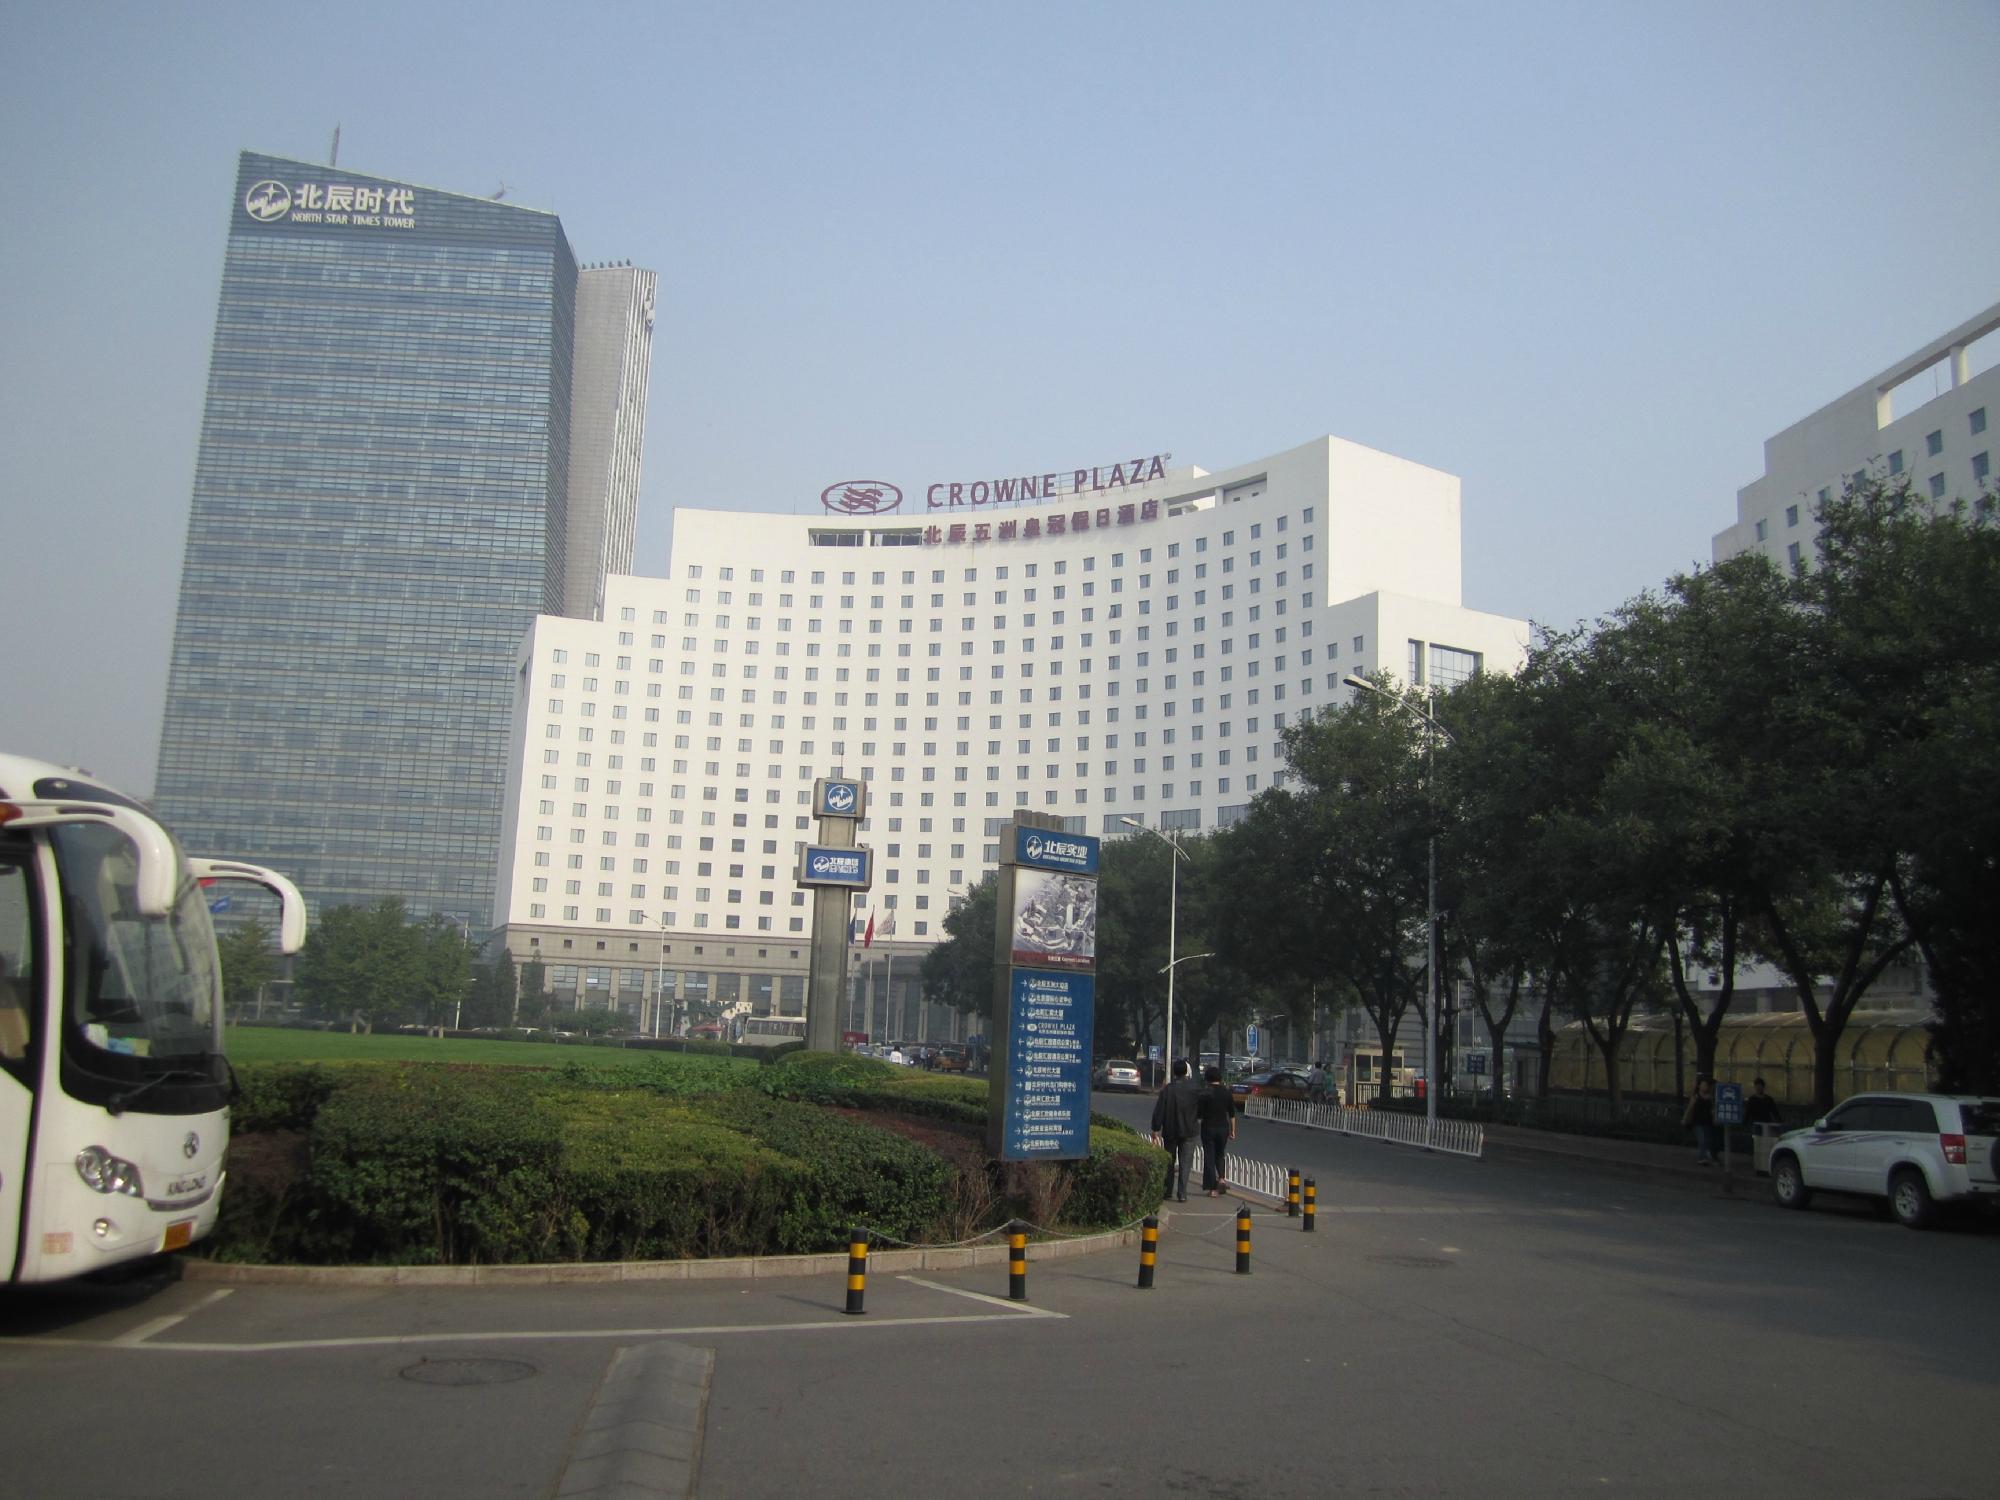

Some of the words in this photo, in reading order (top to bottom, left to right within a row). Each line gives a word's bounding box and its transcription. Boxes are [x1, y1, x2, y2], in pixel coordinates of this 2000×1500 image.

[294, 183, 415, 216] 北辰时代
[291, 212, 322, 223] NORTH
[325, 213, 348, 225] STAR
[353, 215, 380, 226] TIMES
[384, 217, 415, 229] TOWER
[927, 473, 1057, 508] CROWNE
[1074, 455, 1165, 494] PLAZA
[923, 499, 1159, 545] 北辰五洲皇冠假日酒店
[1043, 840, 1088, 859] 北辰实业
